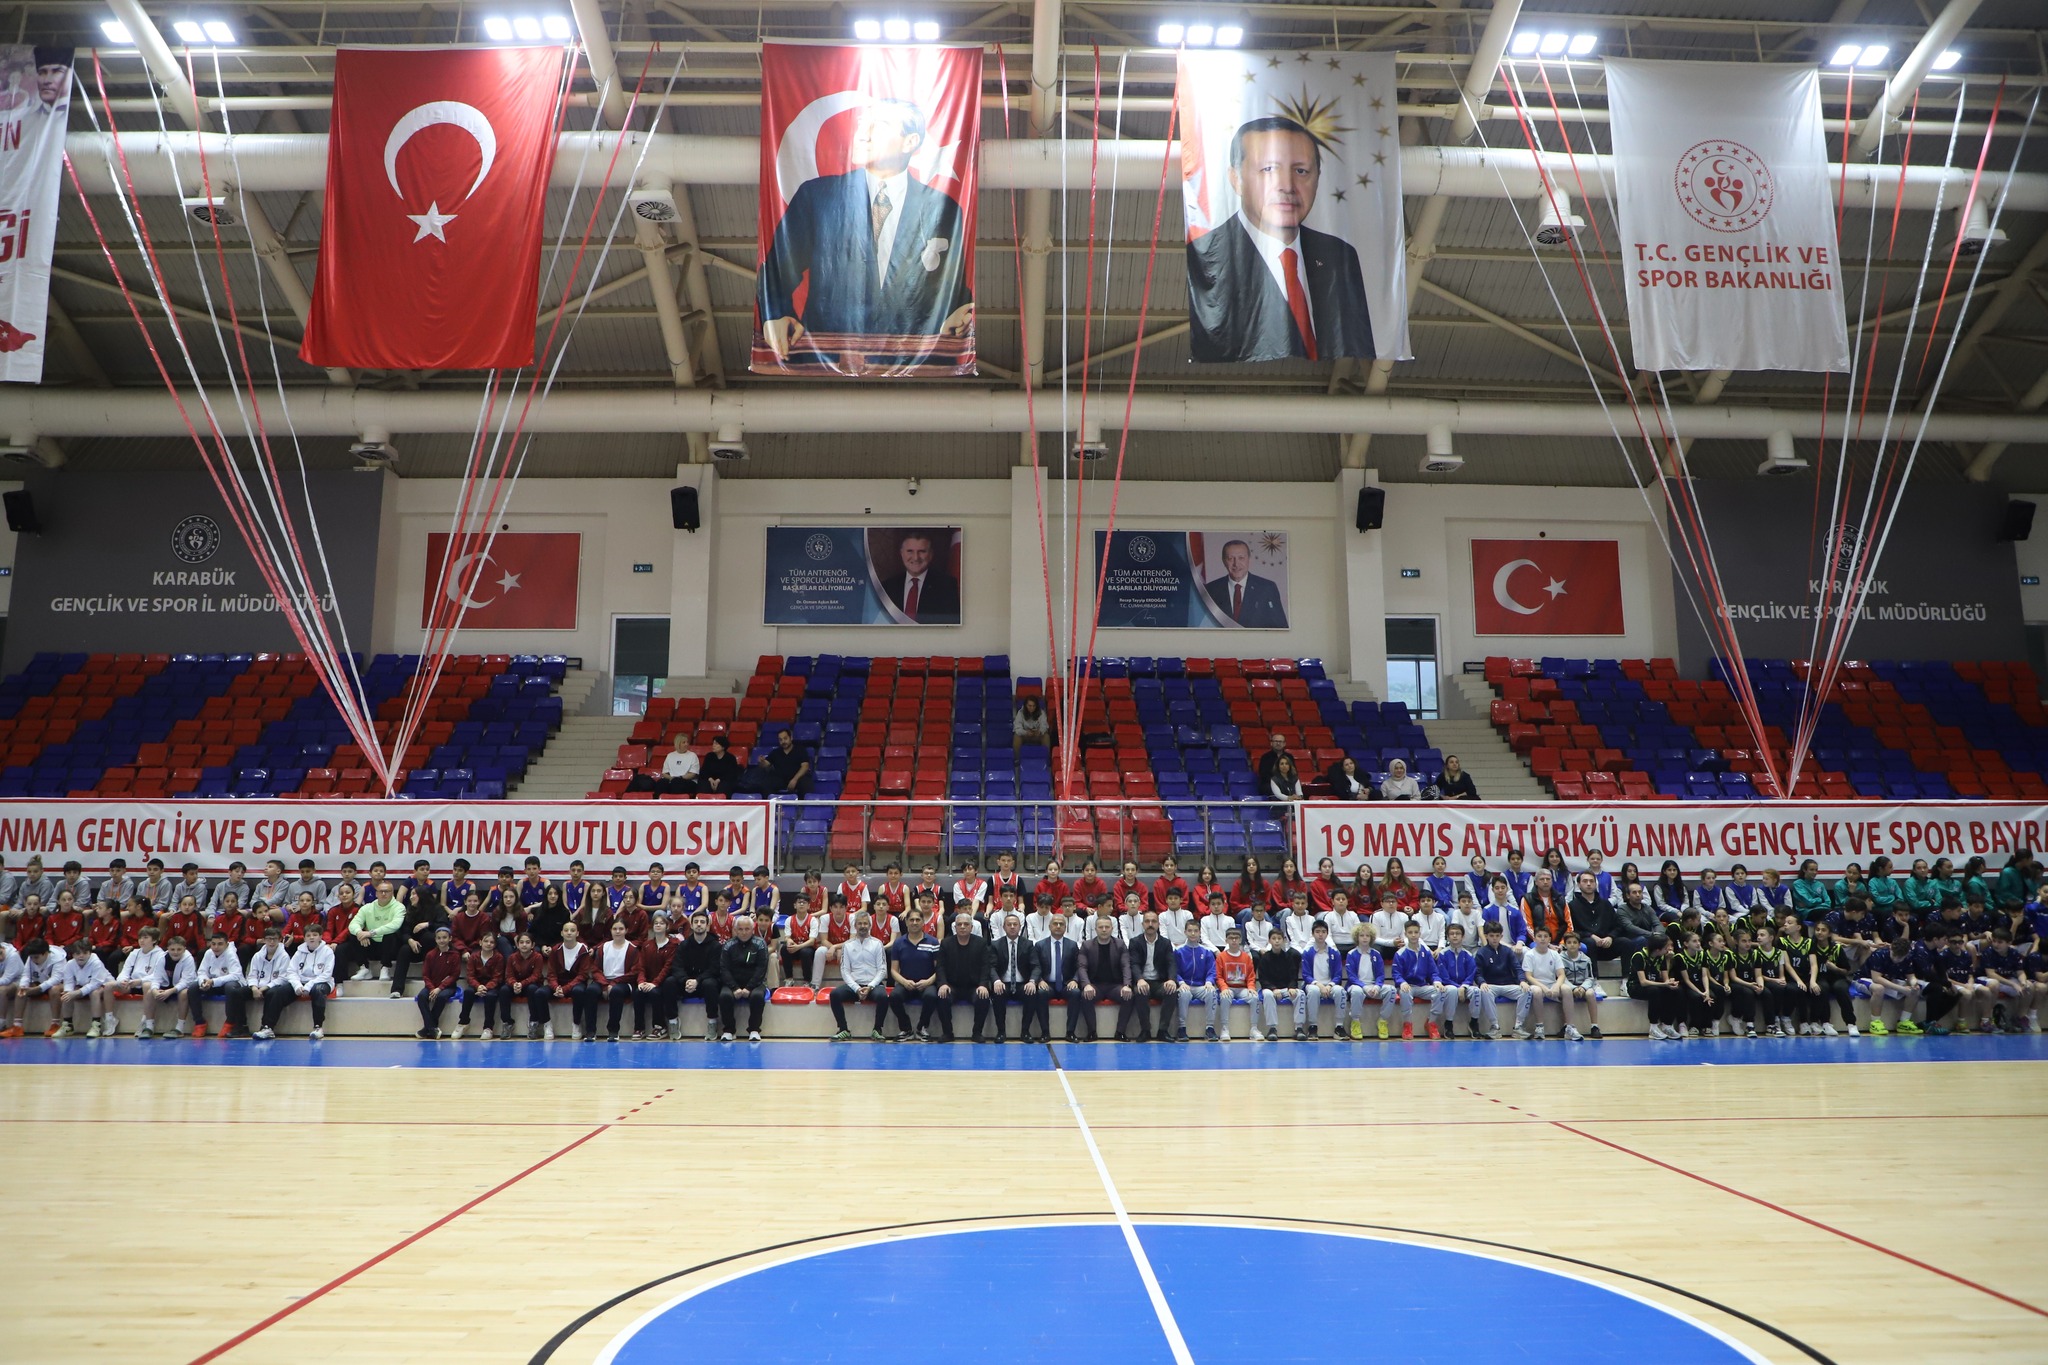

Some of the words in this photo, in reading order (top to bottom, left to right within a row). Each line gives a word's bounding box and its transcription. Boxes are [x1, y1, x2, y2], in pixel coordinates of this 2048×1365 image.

[1634, 243, 1677, 262] T.C.
[1684, 242, 1790, 268] GENÇLİK
[1798, 246, 1829, 265] VE
[1637, 269, 1698, 289] SPOR
[1705, 269, 1832, 290] BAKANLIĞI
[152, 567, 236, 586] KARABÜK
[780, 576, 790, 584] VE
[791, 576, 856, 584] SPORCULARIMIZA
[1105, 576, 1114, 584] VE
[1143, 584, 1178, 592] DİLİYORUM
[51, 594, 123, 616] GENÇLİK
[128, 597, 149, 612] VE
[152, 597, 198, 612] SPOR
[201, 593, 216, 612] İL
[220, 593, 334, 613] MÜDÜÜÜ
[1788, 605, 1811, 619] VE
[1861, 602, 1876, 620] İL
[1879, 603, 1987, 622] MÜDÜRLÜĞÜ
[77, 810, 204, 863] GENÇLİK
[209, 818, 245, 854] VE
[252, 819, 332, 855] SPOR
[339, 819, 531, 855] BAYRAMIMIZ
[540, 819, 637, 855] KUTLU
[646, 819, 748, 856] OLSUN
[1321, 823, 1355, 857] 19
[1363, 822, 1454, 857] MAYIS
[1626, 823, 1715, 857] ANMA
[1720, 814, 1842, 866] GENÇLİK
[1845, 821, 1884, 855] VE
[1888, 820, 1965, 855] SPOR
[1969, 819, 2048, 854] BAYR
